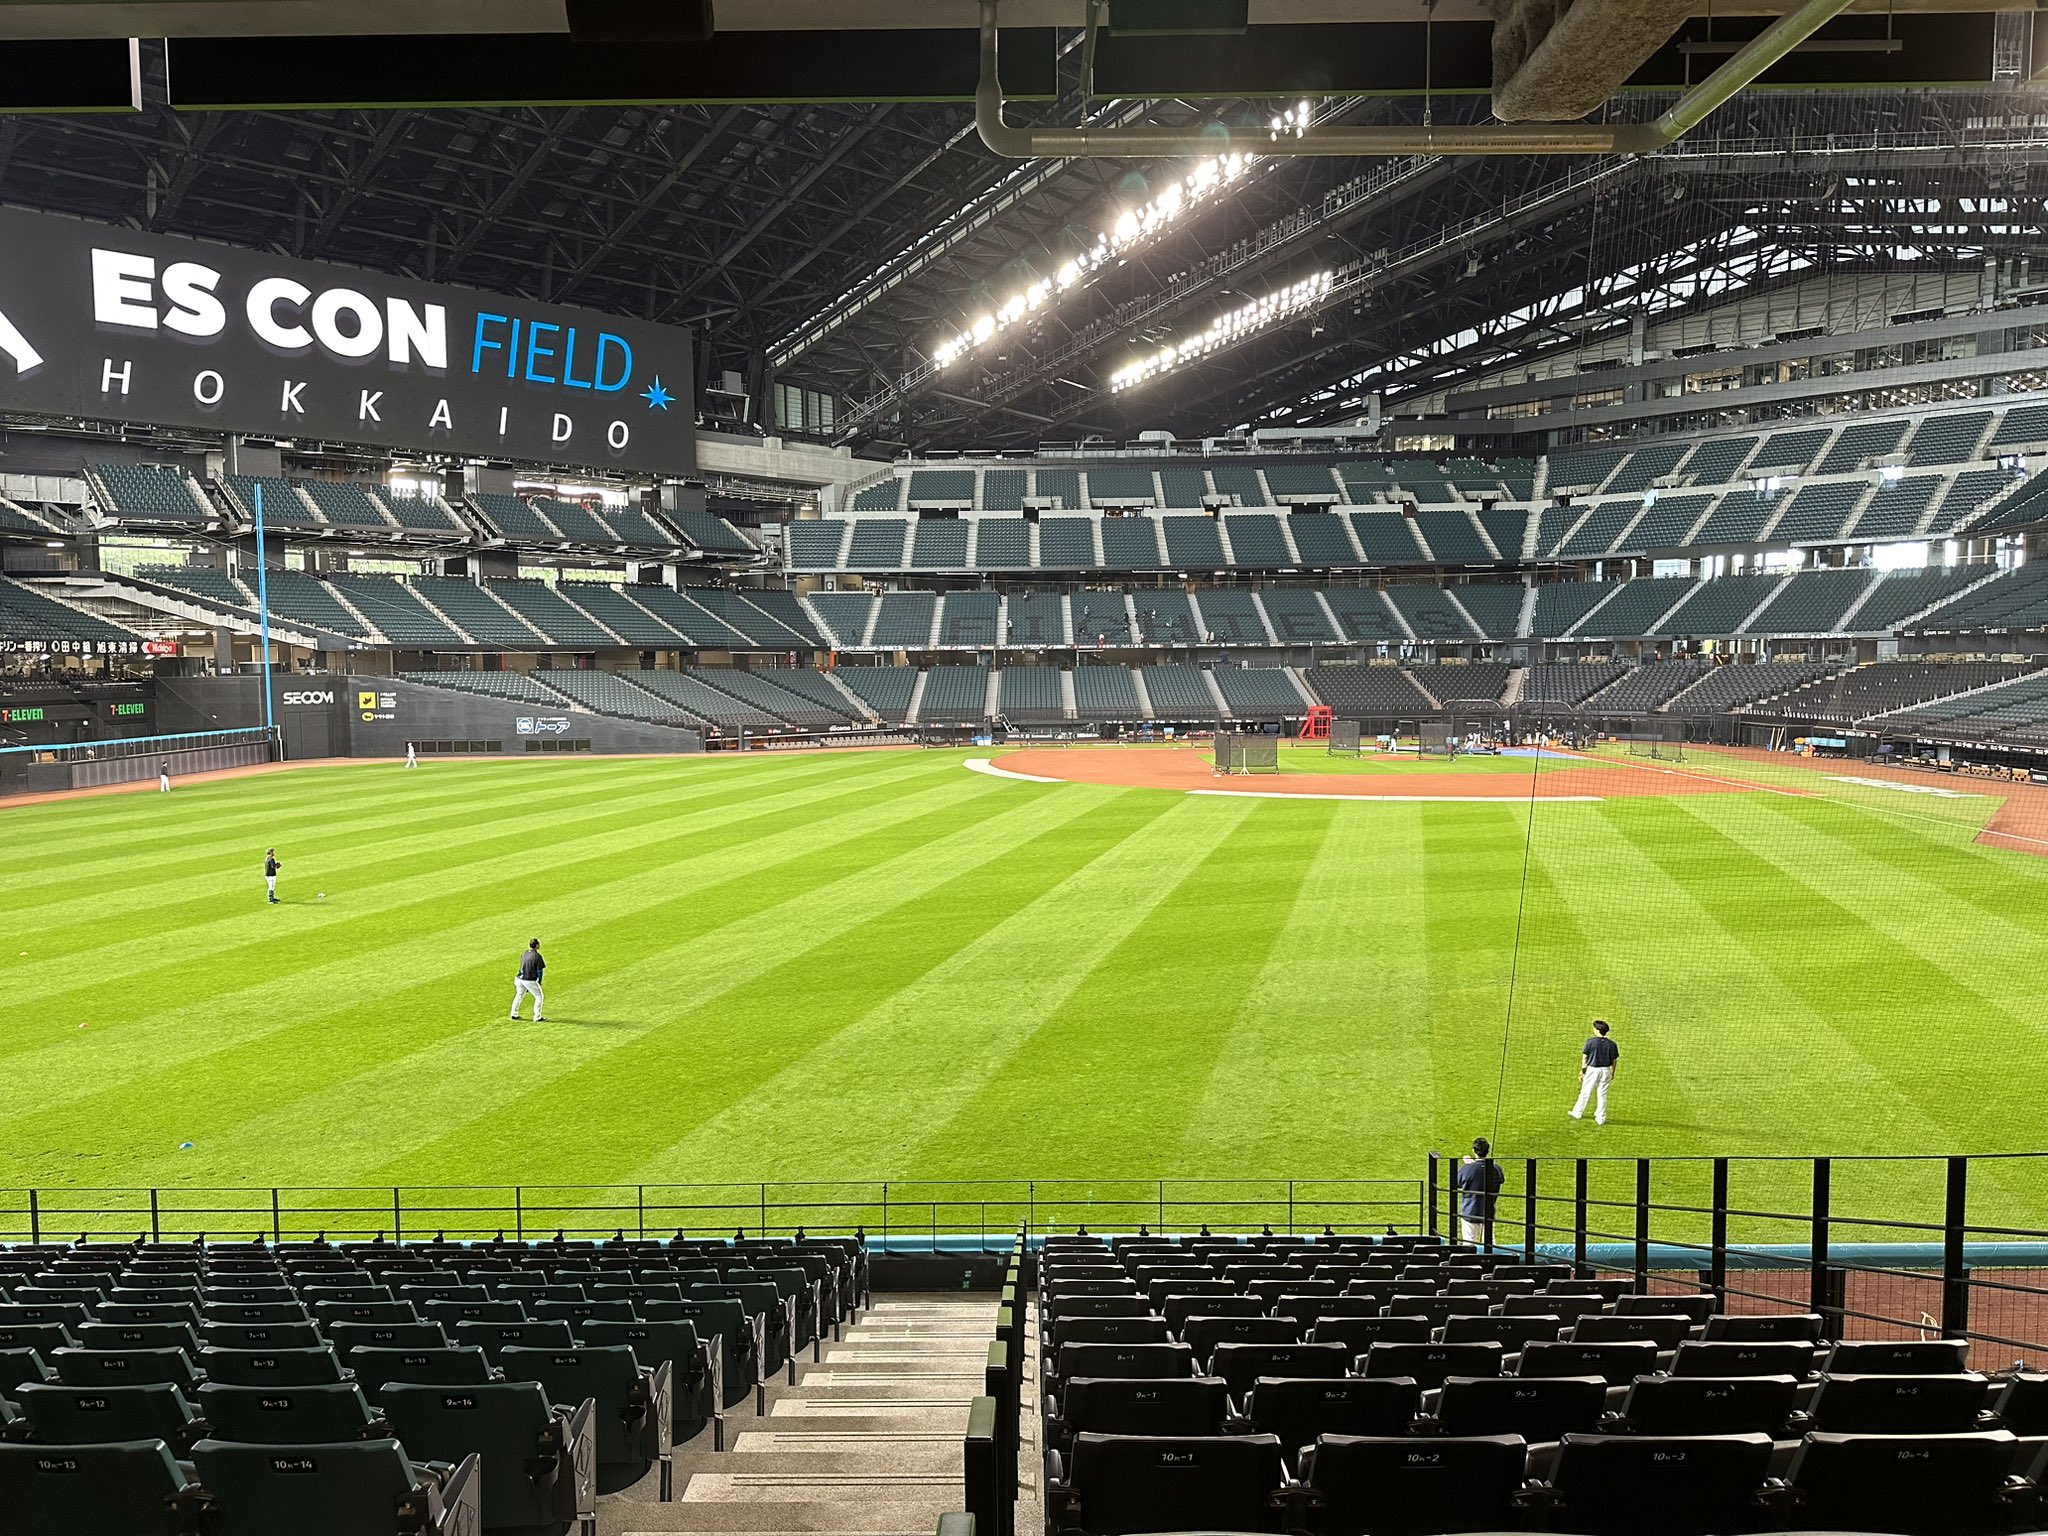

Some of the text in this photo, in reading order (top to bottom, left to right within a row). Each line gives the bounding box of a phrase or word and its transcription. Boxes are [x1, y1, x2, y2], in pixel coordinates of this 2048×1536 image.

[91, 248, 635, 394] ES CON FIELD
[100, 357, 630, 450] HOKKAIDO
[949, 610, 1461, 640] FIGHTERS
[283, 691, 335, 705] SECOM
